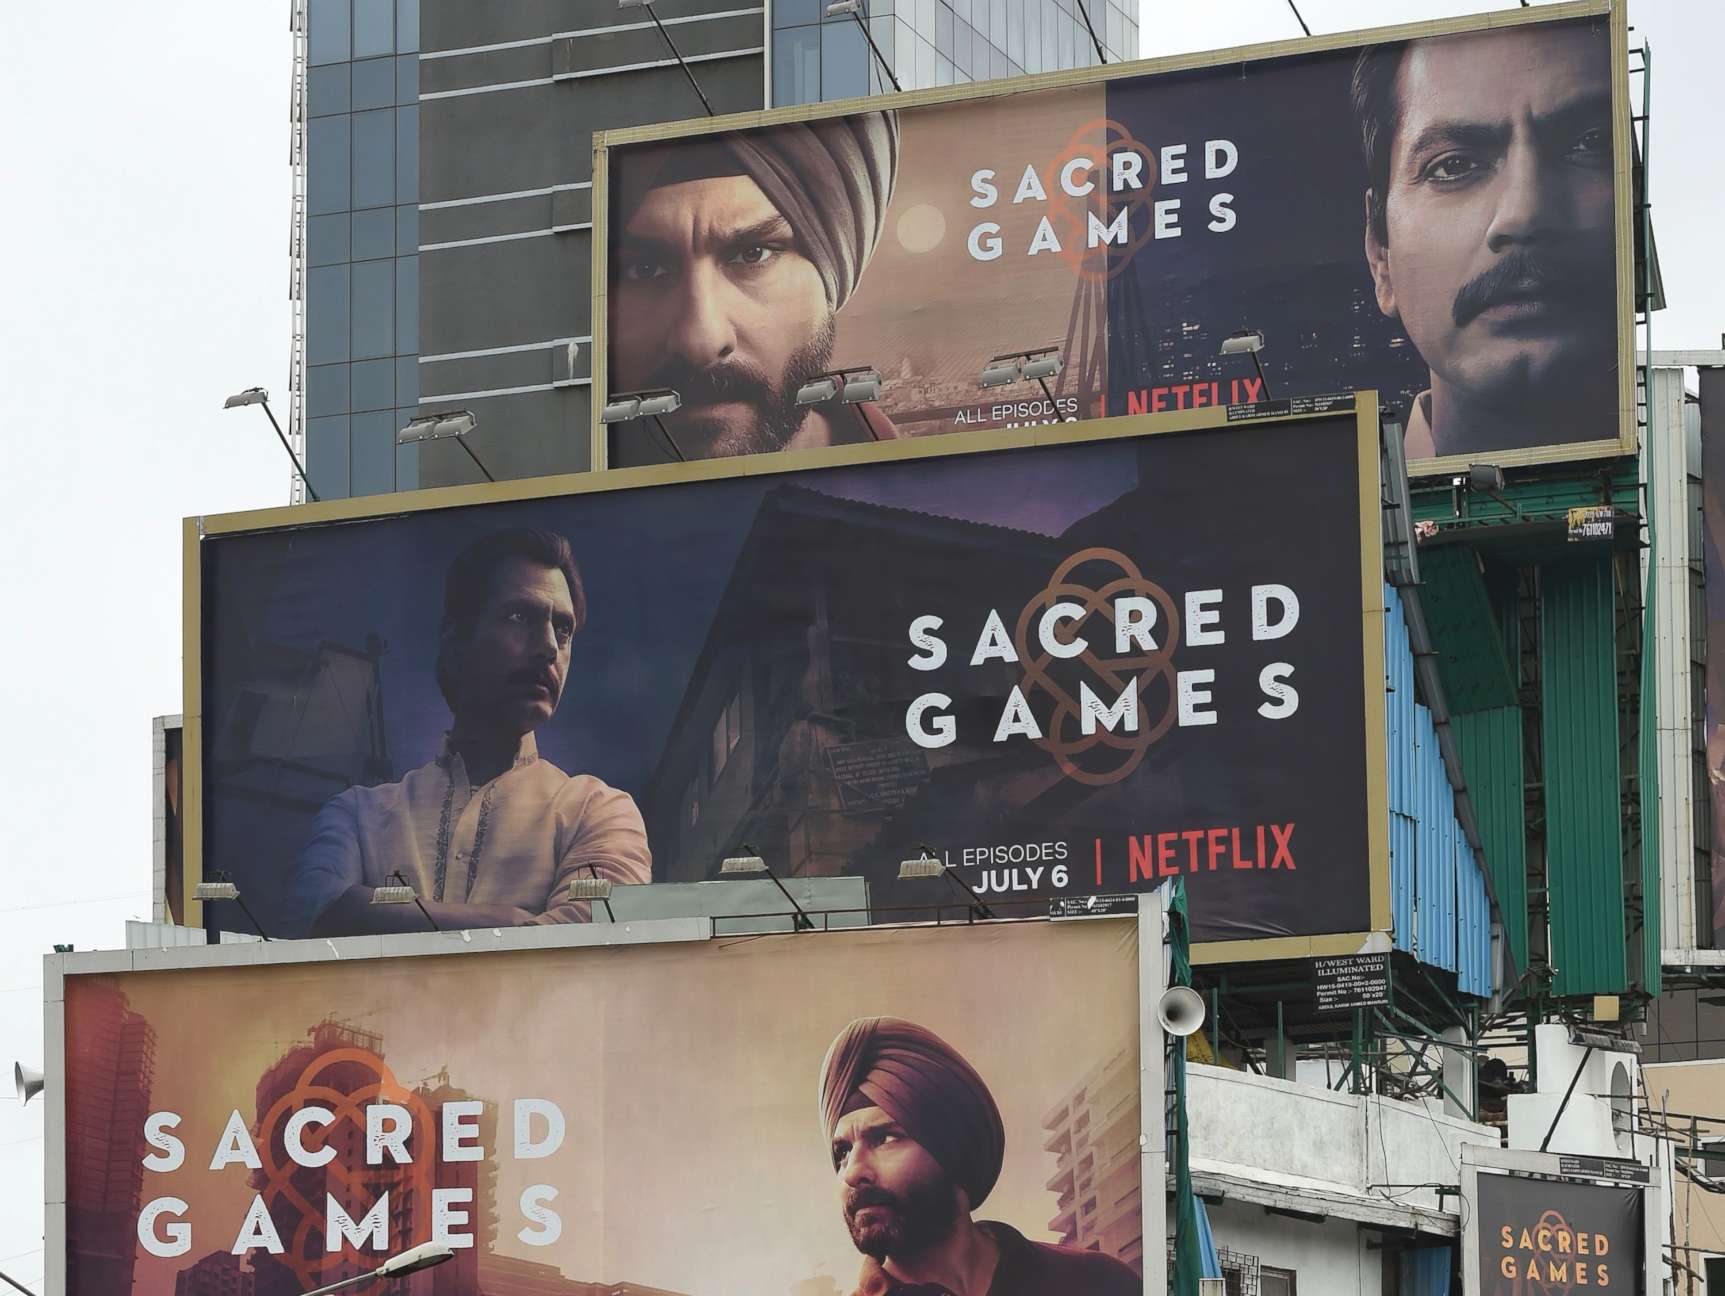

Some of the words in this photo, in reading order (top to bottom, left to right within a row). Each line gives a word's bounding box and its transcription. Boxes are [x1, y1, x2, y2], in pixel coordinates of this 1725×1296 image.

[969, 140, 1239, 208] SACRED
[967, 193, 1237, 261] GAMES
[954, 409, 991, 425] ALL
[992, 397, 1079, 420] EPISODES
[907, 584, 1301, 672] SACRED
[905, 661, 1300, 749] GAMES
[963, 841, 1069, 866] EPISODES
[971, 866, 1045, 894] JULY
[1051, 865, 1069, 888] 6
[1128, 822, 1297, 883] NETFLIX
[1317, 964, 1384, 976] ILLUMINATED
[142, 1098, 566, 1173] SACRED
[136, 1184, 563, 1257] GAMES
[1501, 1226, 1609, 1256] SACRED
[1501, 1256, 1609, 1286] GAMES
